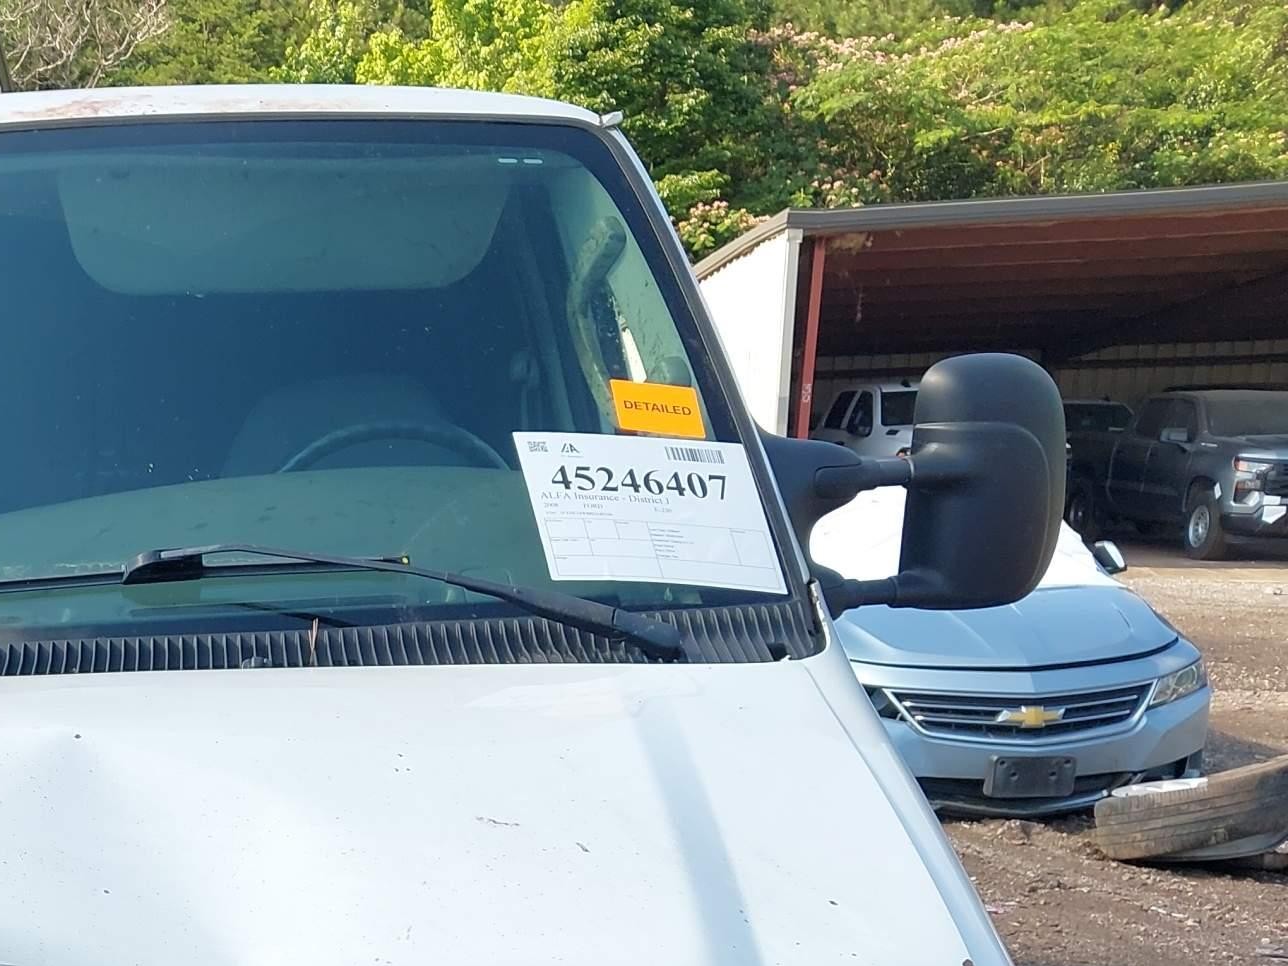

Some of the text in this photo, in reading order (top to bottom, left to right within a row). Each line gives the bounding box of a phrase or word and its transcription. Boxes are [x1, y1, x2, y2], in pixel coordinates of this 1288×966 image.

[623, 399, 692, 416] DETAILED
[551, 465, 727, 500] 45246407
[541, 491, 571, 500] ALFA
[574, 492, 620, 501] Insurance
[628, 494, 663, 504] District
